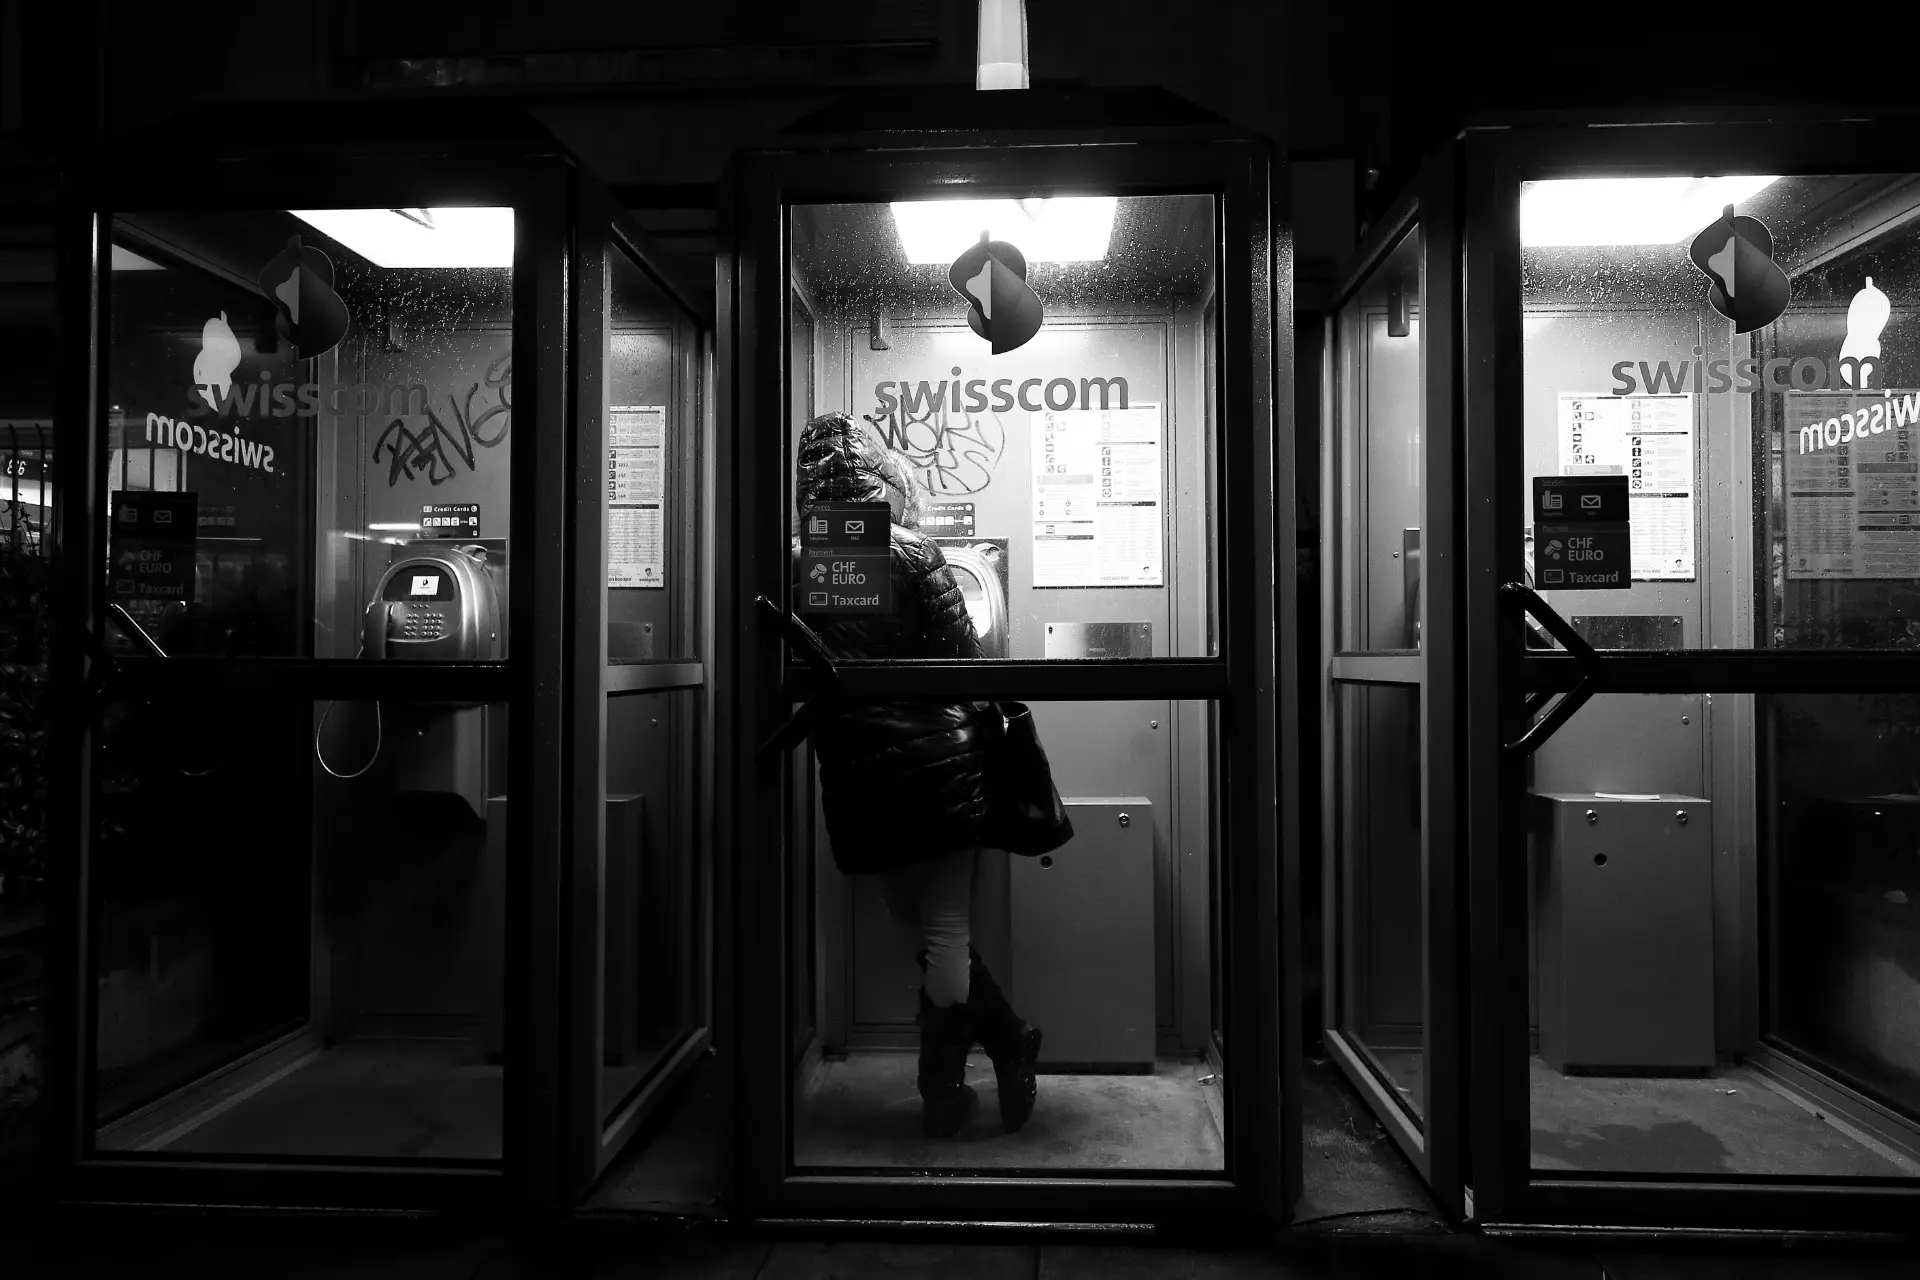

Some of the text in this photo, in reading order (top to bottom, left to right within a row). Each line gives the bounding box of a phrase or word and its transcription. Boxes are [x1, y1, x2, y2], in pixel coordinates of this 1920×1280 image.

[1611, 344, 1882, 395] swisscom
[186, 370, 429, 418] swisscom
[874, 366, 1129, 415] swisscom
[1567, 537, 1594, 549] CHF
[139, 549, 164, 561] CHF
[1568, 549, 1605, 561] EURO
[139, 562, 173, 574] EURO
[831, 561, 856, 573] CHF
[832, 573, 866, 585] EURO
[1568, 570, 1620, 583] Taxcard
[139, 582, 184, 595] Taxcard
[831, 594, 880, 606] Taxcard
